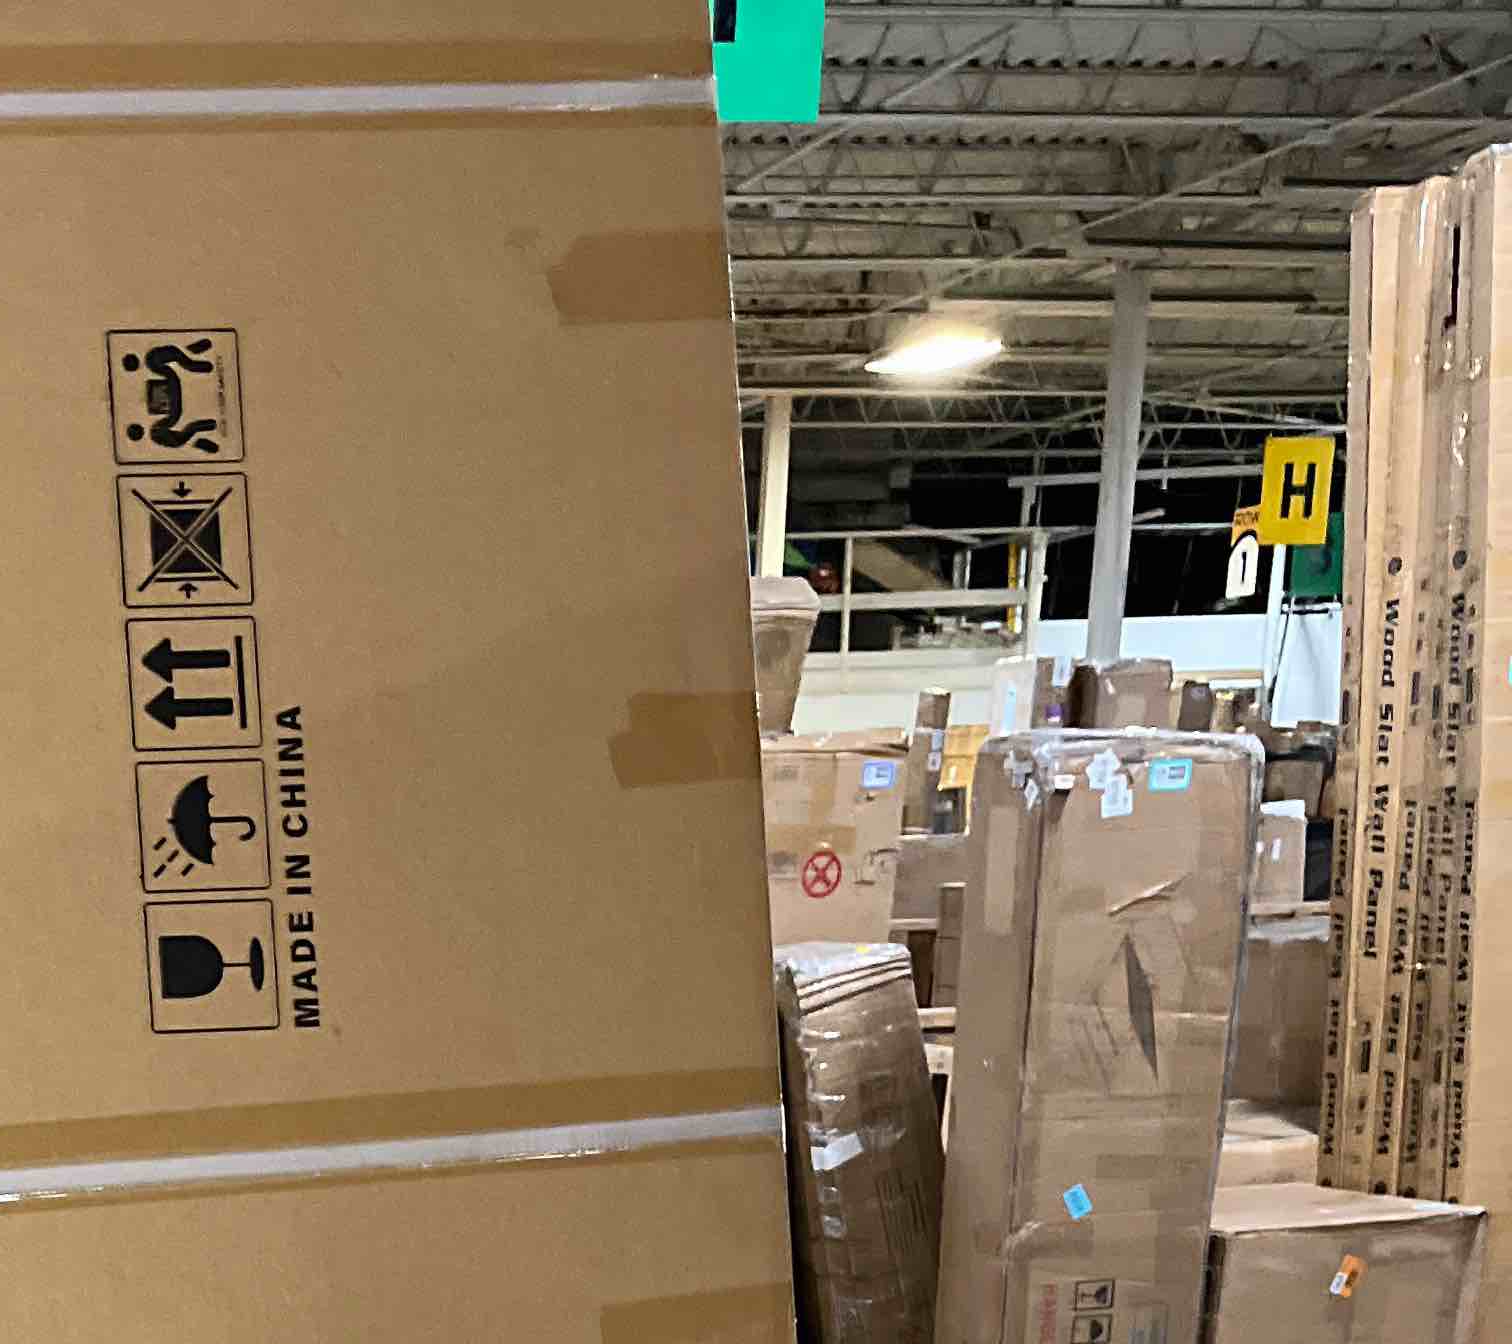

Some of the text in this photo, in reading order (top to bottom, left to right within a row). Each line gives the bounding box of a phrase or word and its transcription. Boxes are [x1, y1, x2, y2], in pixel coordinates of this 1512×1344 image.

[1280, 462, 1317, 519] H
[276, 706, 320, 1027] MADE IN CHINA
[1363, 599, 1401, 958] Wood Slat Wall Panel
